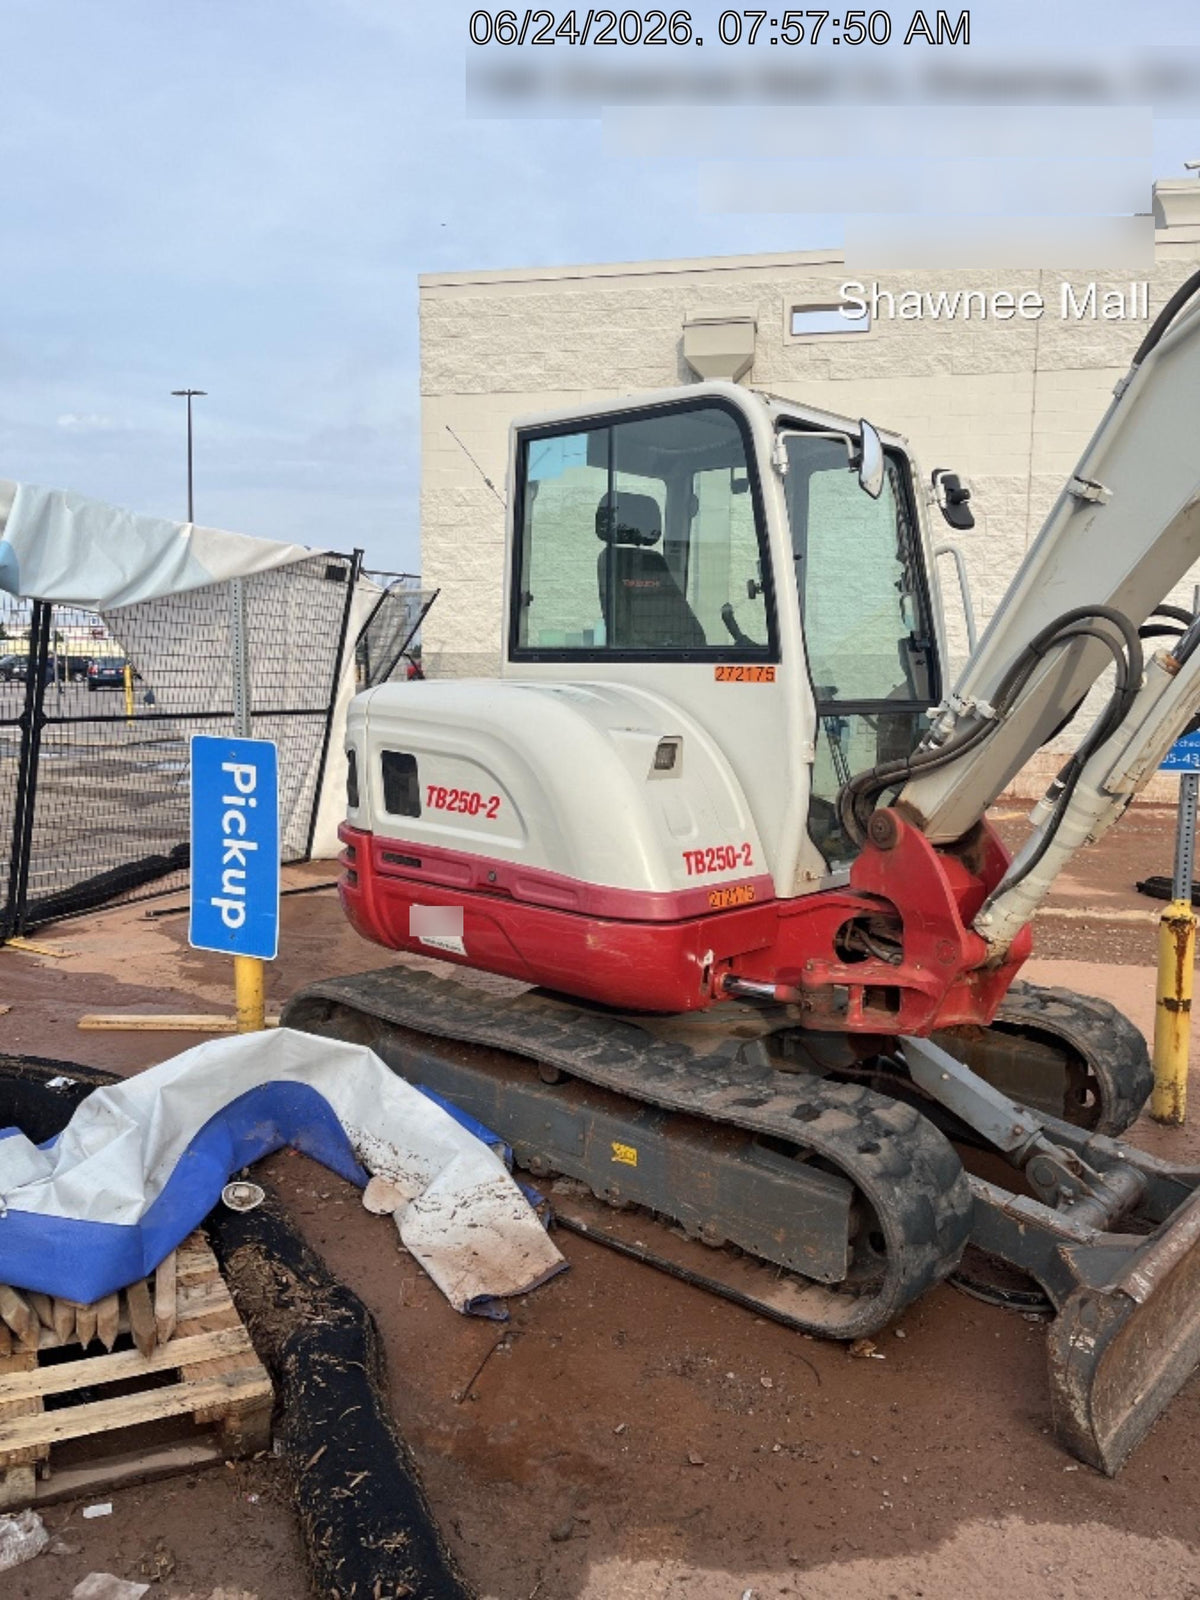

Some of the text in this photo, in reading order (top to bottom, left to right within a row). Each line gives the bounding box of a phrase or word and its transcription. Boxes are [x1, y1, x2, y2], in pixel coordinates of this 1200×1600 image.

[715, 666, 775, 682] 272175
[426, 785, 500, 819] TB250-2
[210, 762, 258, 929] Pickup
[682, 842, 753, 876] TB250-2
